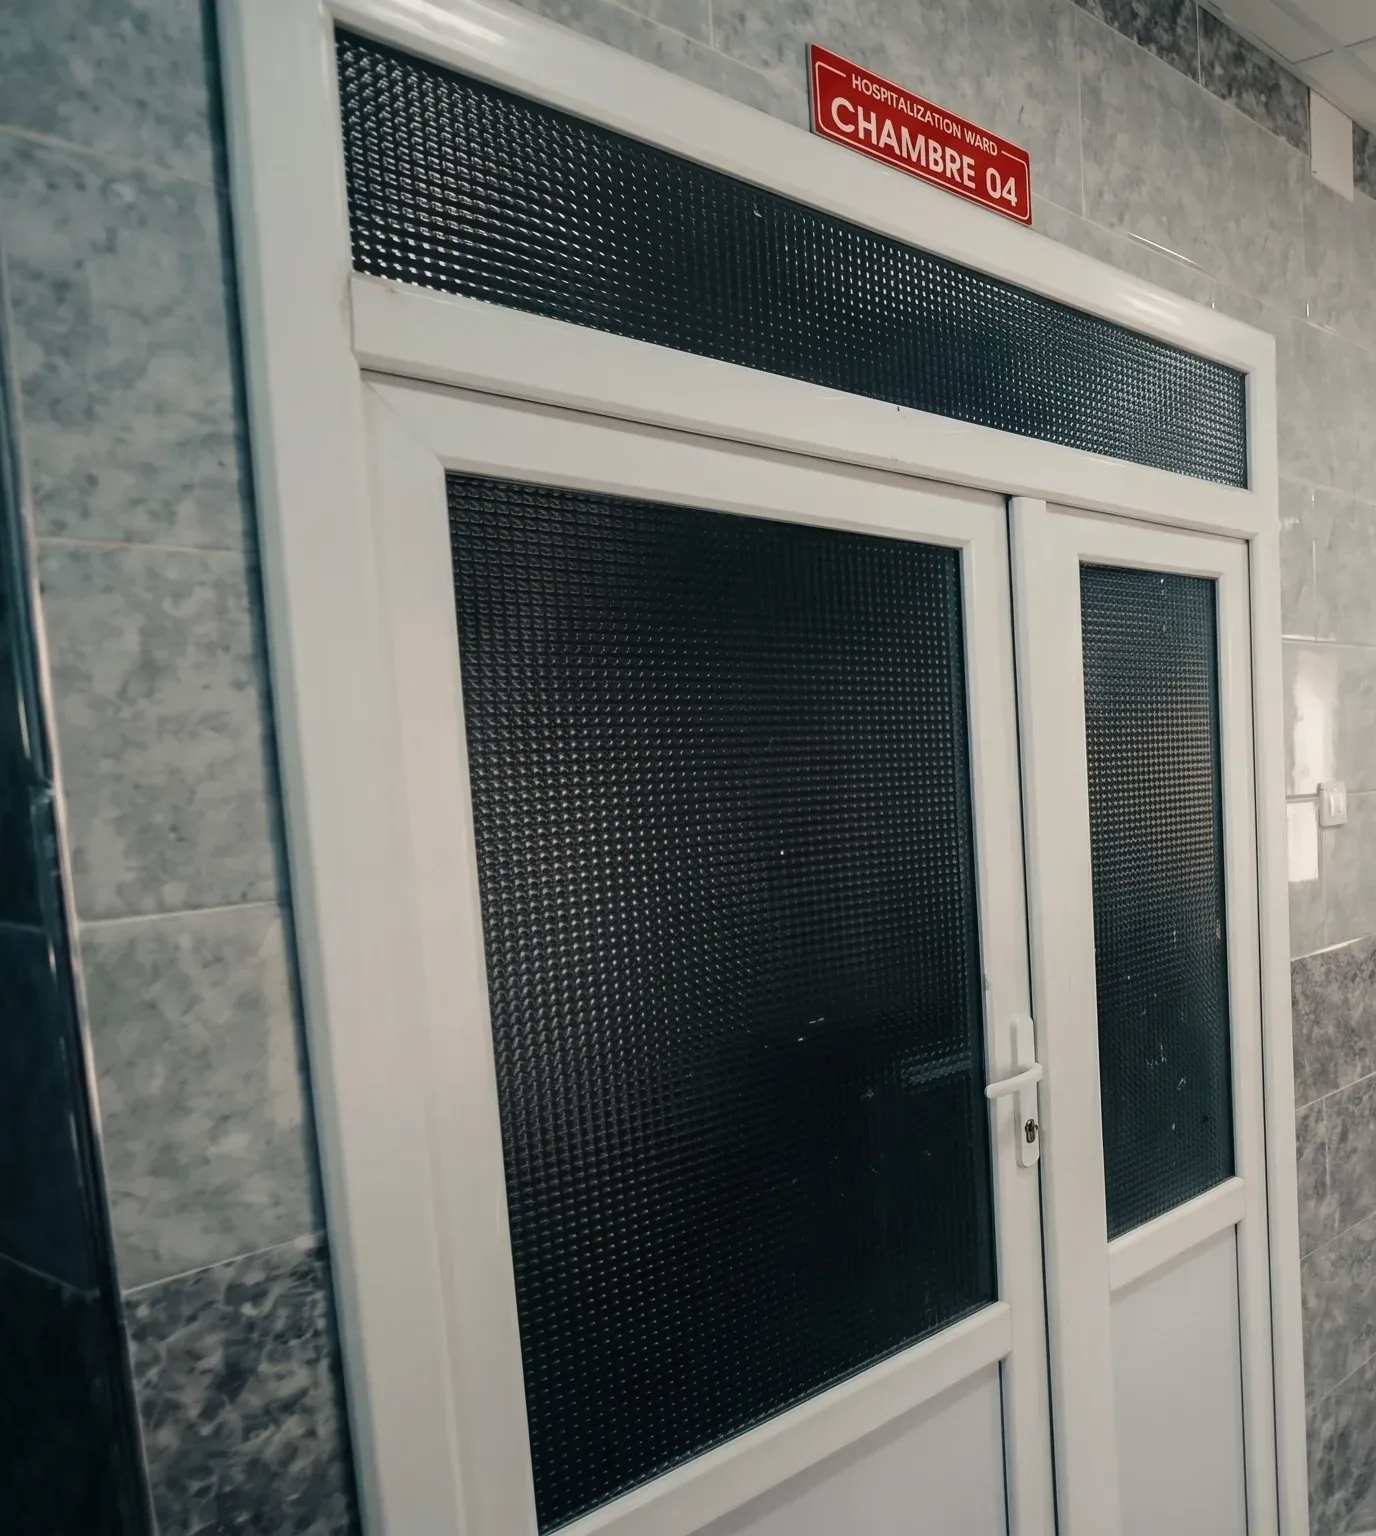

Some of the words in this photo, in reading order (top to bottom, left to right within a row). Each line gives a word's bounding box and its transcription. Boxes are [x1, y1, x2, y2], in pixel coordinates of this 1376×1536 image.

[831, 97, 976, 189] CHAMBRE
[985, 167, 1017, 206] 04
[852, 73, 961, 140] HOSPITALIZATION
[964, 128, 998, 156] WARD
